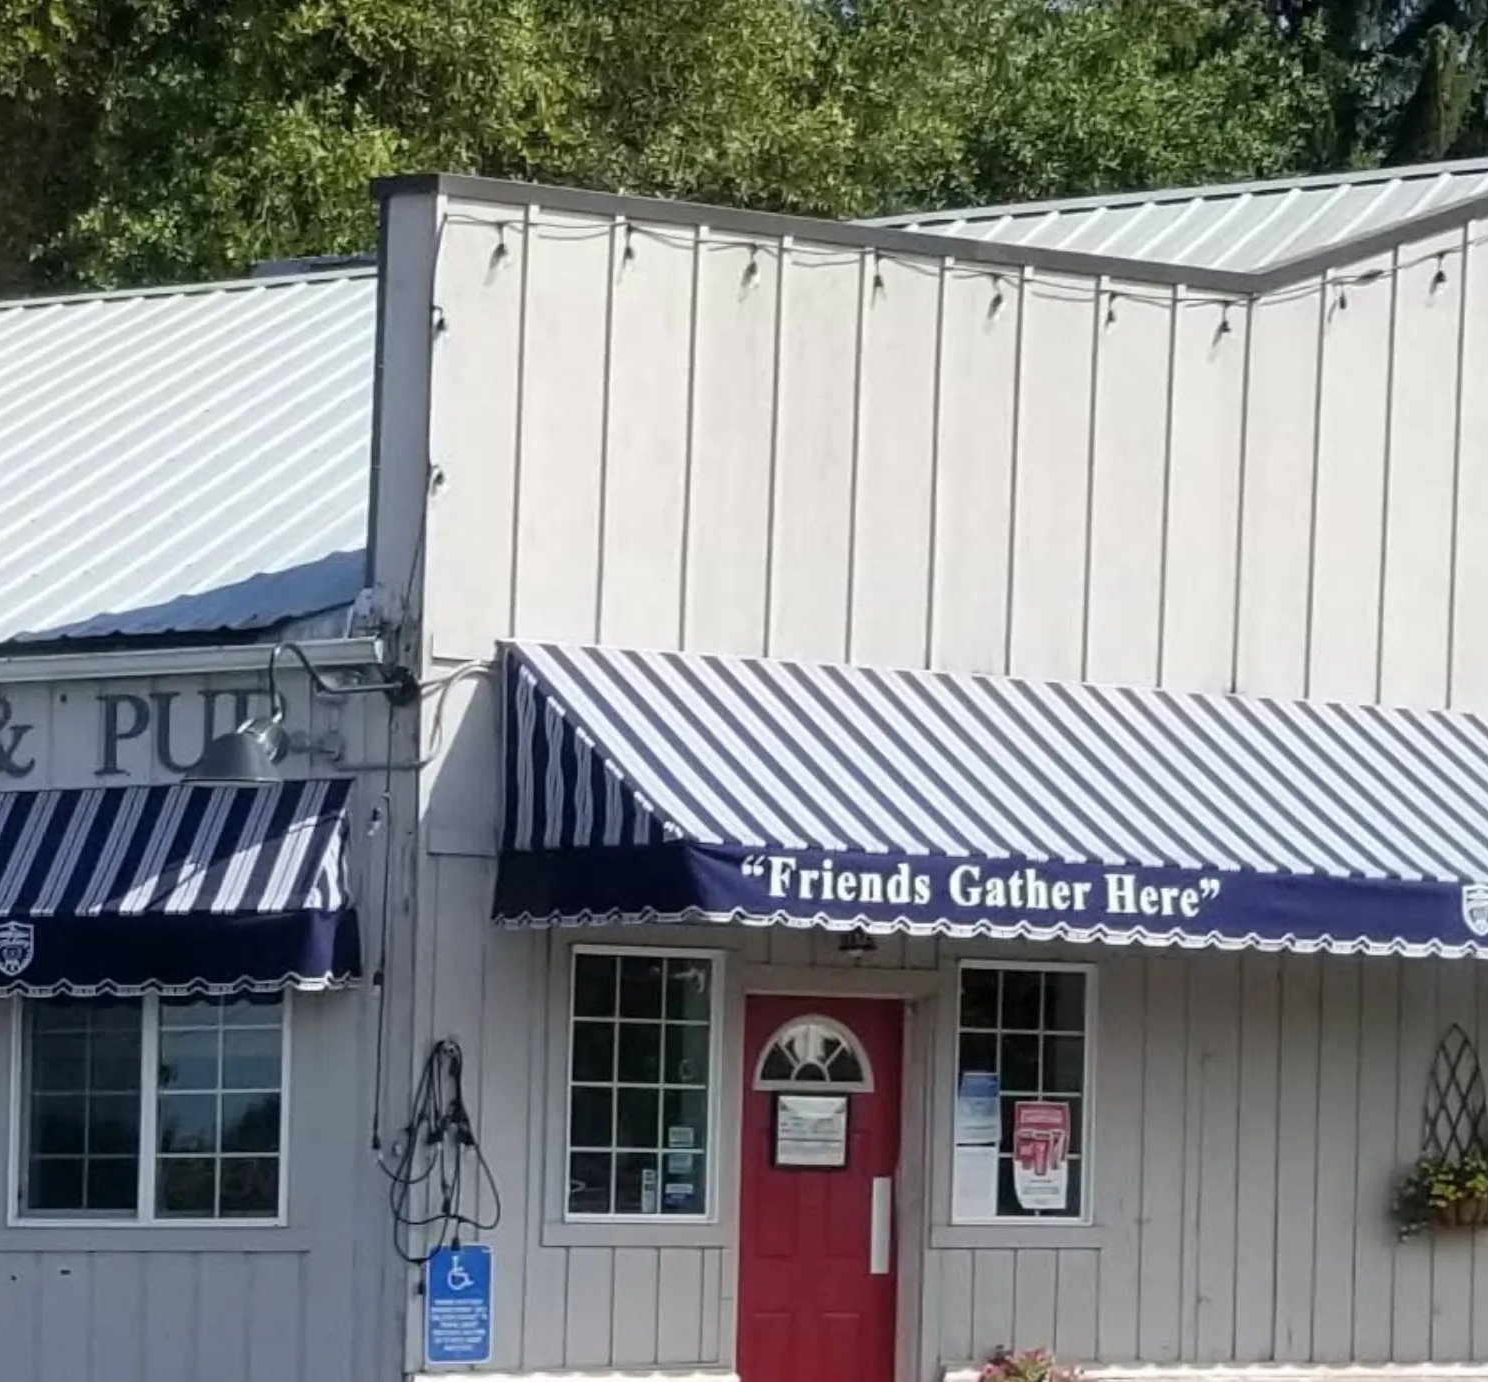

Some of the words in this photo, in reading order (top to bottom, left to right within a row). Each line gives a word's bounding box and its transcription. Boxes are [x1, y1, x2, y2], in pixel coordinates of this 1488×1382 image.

[741, 854, 932, 907] “Friends
[949, 863, 1092, 909] Gather
[1104, 873, 1221, 919] Here”
